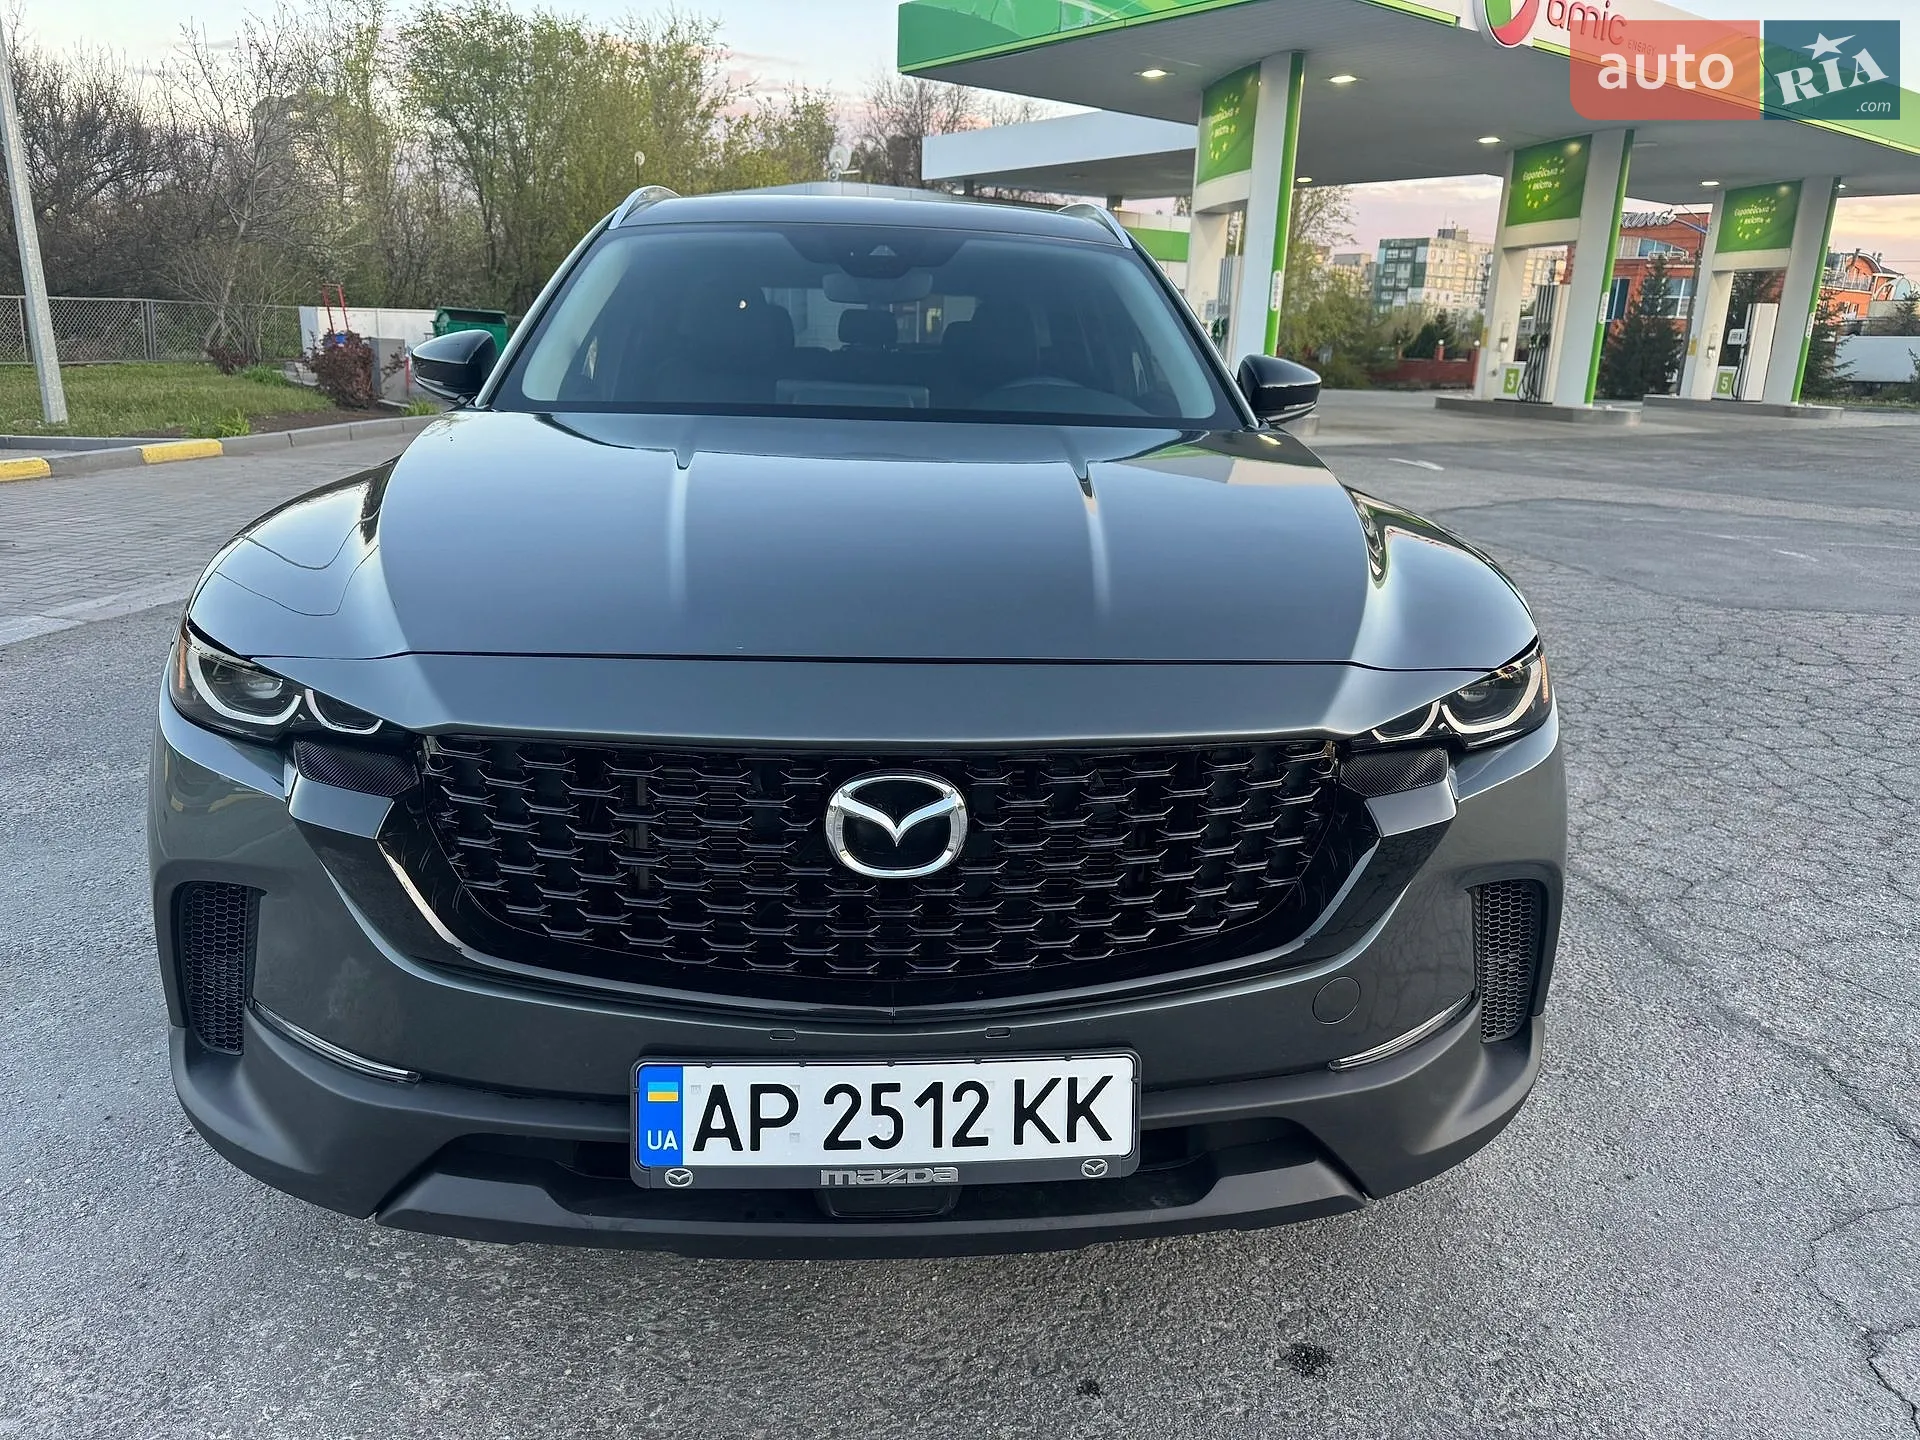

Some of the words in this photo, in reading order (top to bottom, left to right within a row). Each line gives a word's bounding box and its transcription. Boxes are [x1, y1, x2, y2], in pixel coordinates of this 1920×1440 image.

[1547, 0, 1627, 45] amic
[1627, 40, 1657, 56] ENERGY
[1507, 373, 1515, 390] 3
[1721, 376, 1729, 391] 5
[692, 1084, 799, 1152] AP
[823, 1080, 990, 1151] 2512
[1013, 1075, 1114, 1146] KK
[647, 1130, 679, 1150] UA
[820, 1166, 959, 1187] mazda
